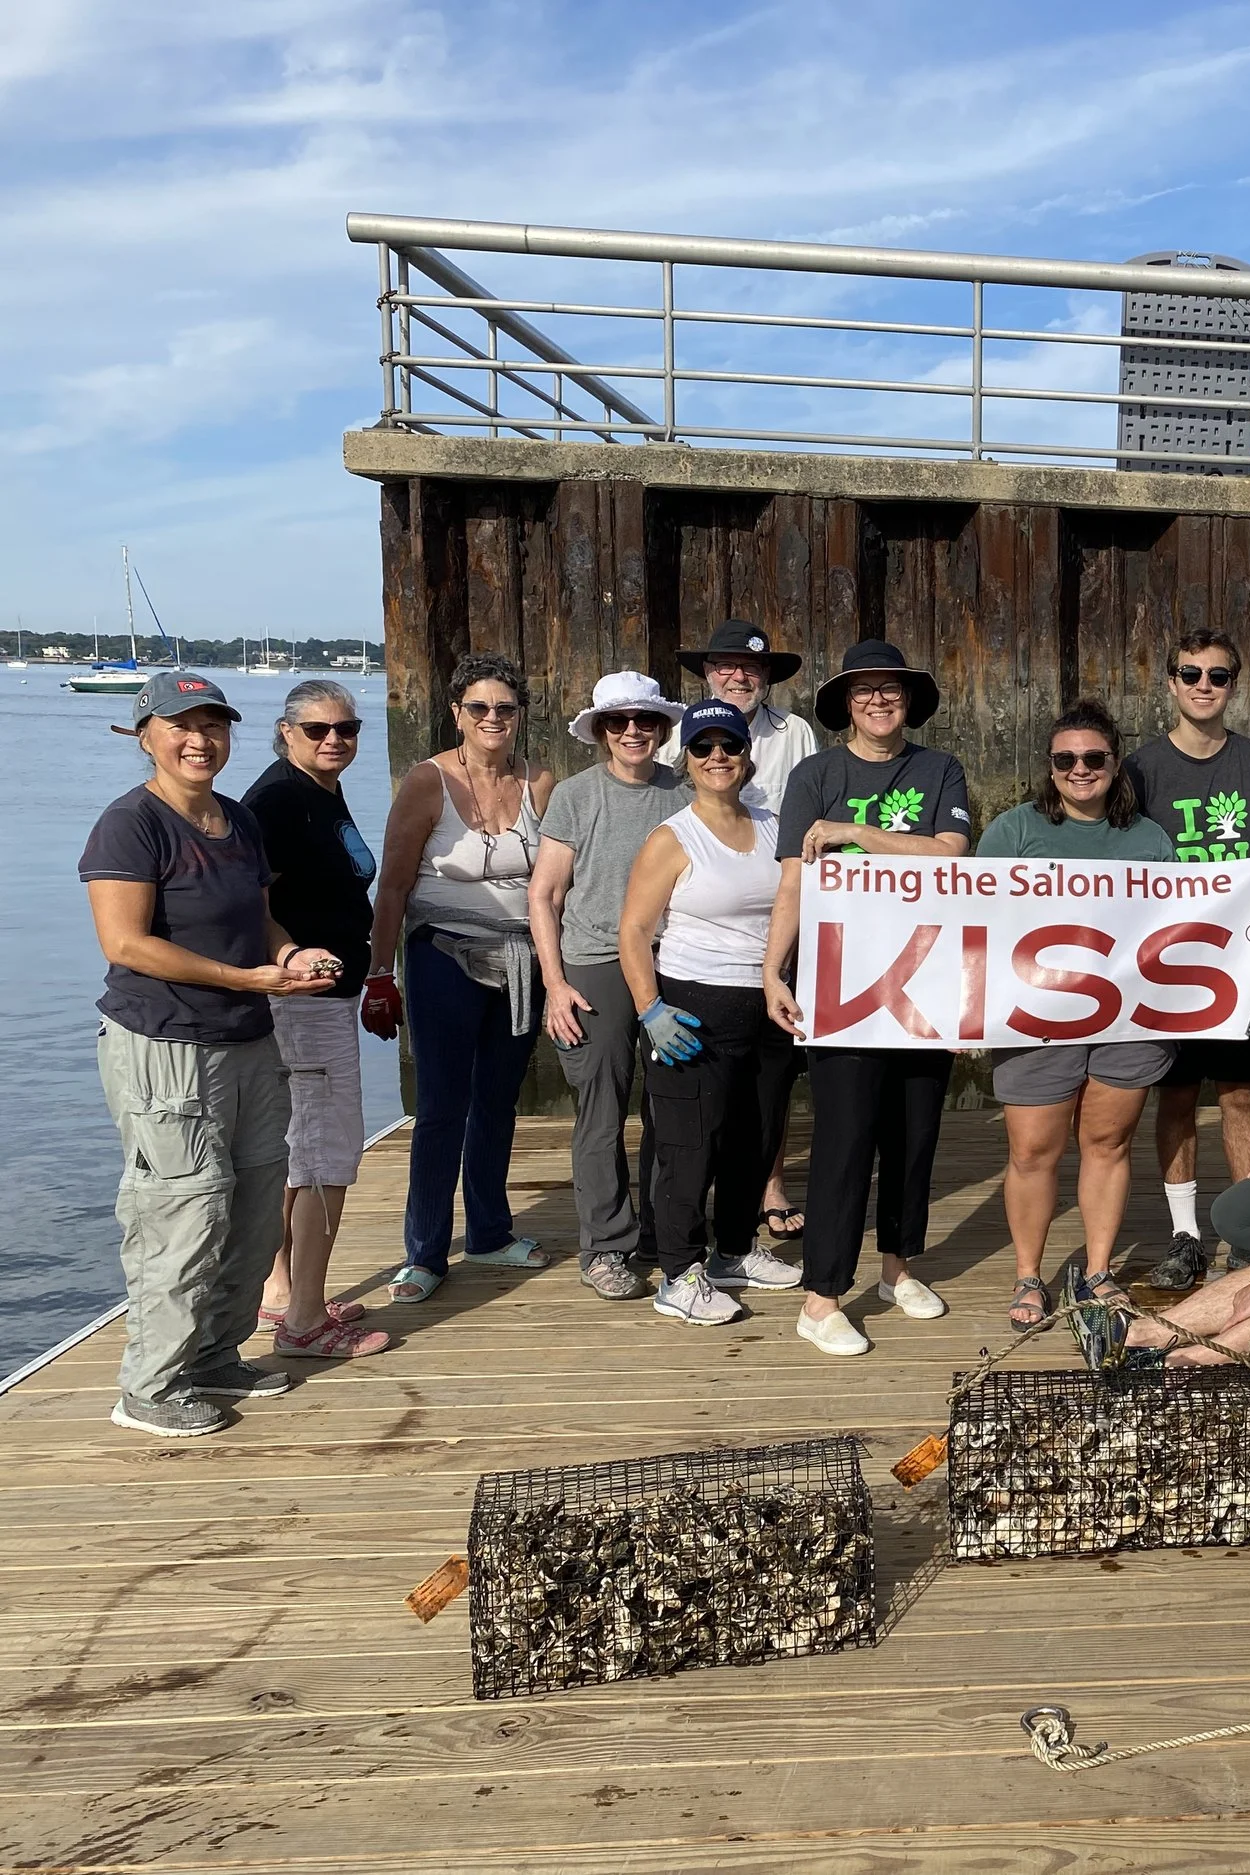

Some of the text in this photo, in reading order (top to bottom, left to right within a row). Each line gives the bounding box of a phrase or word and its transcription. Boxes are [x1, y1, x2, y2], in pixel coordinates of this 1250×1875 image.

[819, 859, 1232, 903] Bring the Salon Home
[813, 921, 1238, 1040] KISS
